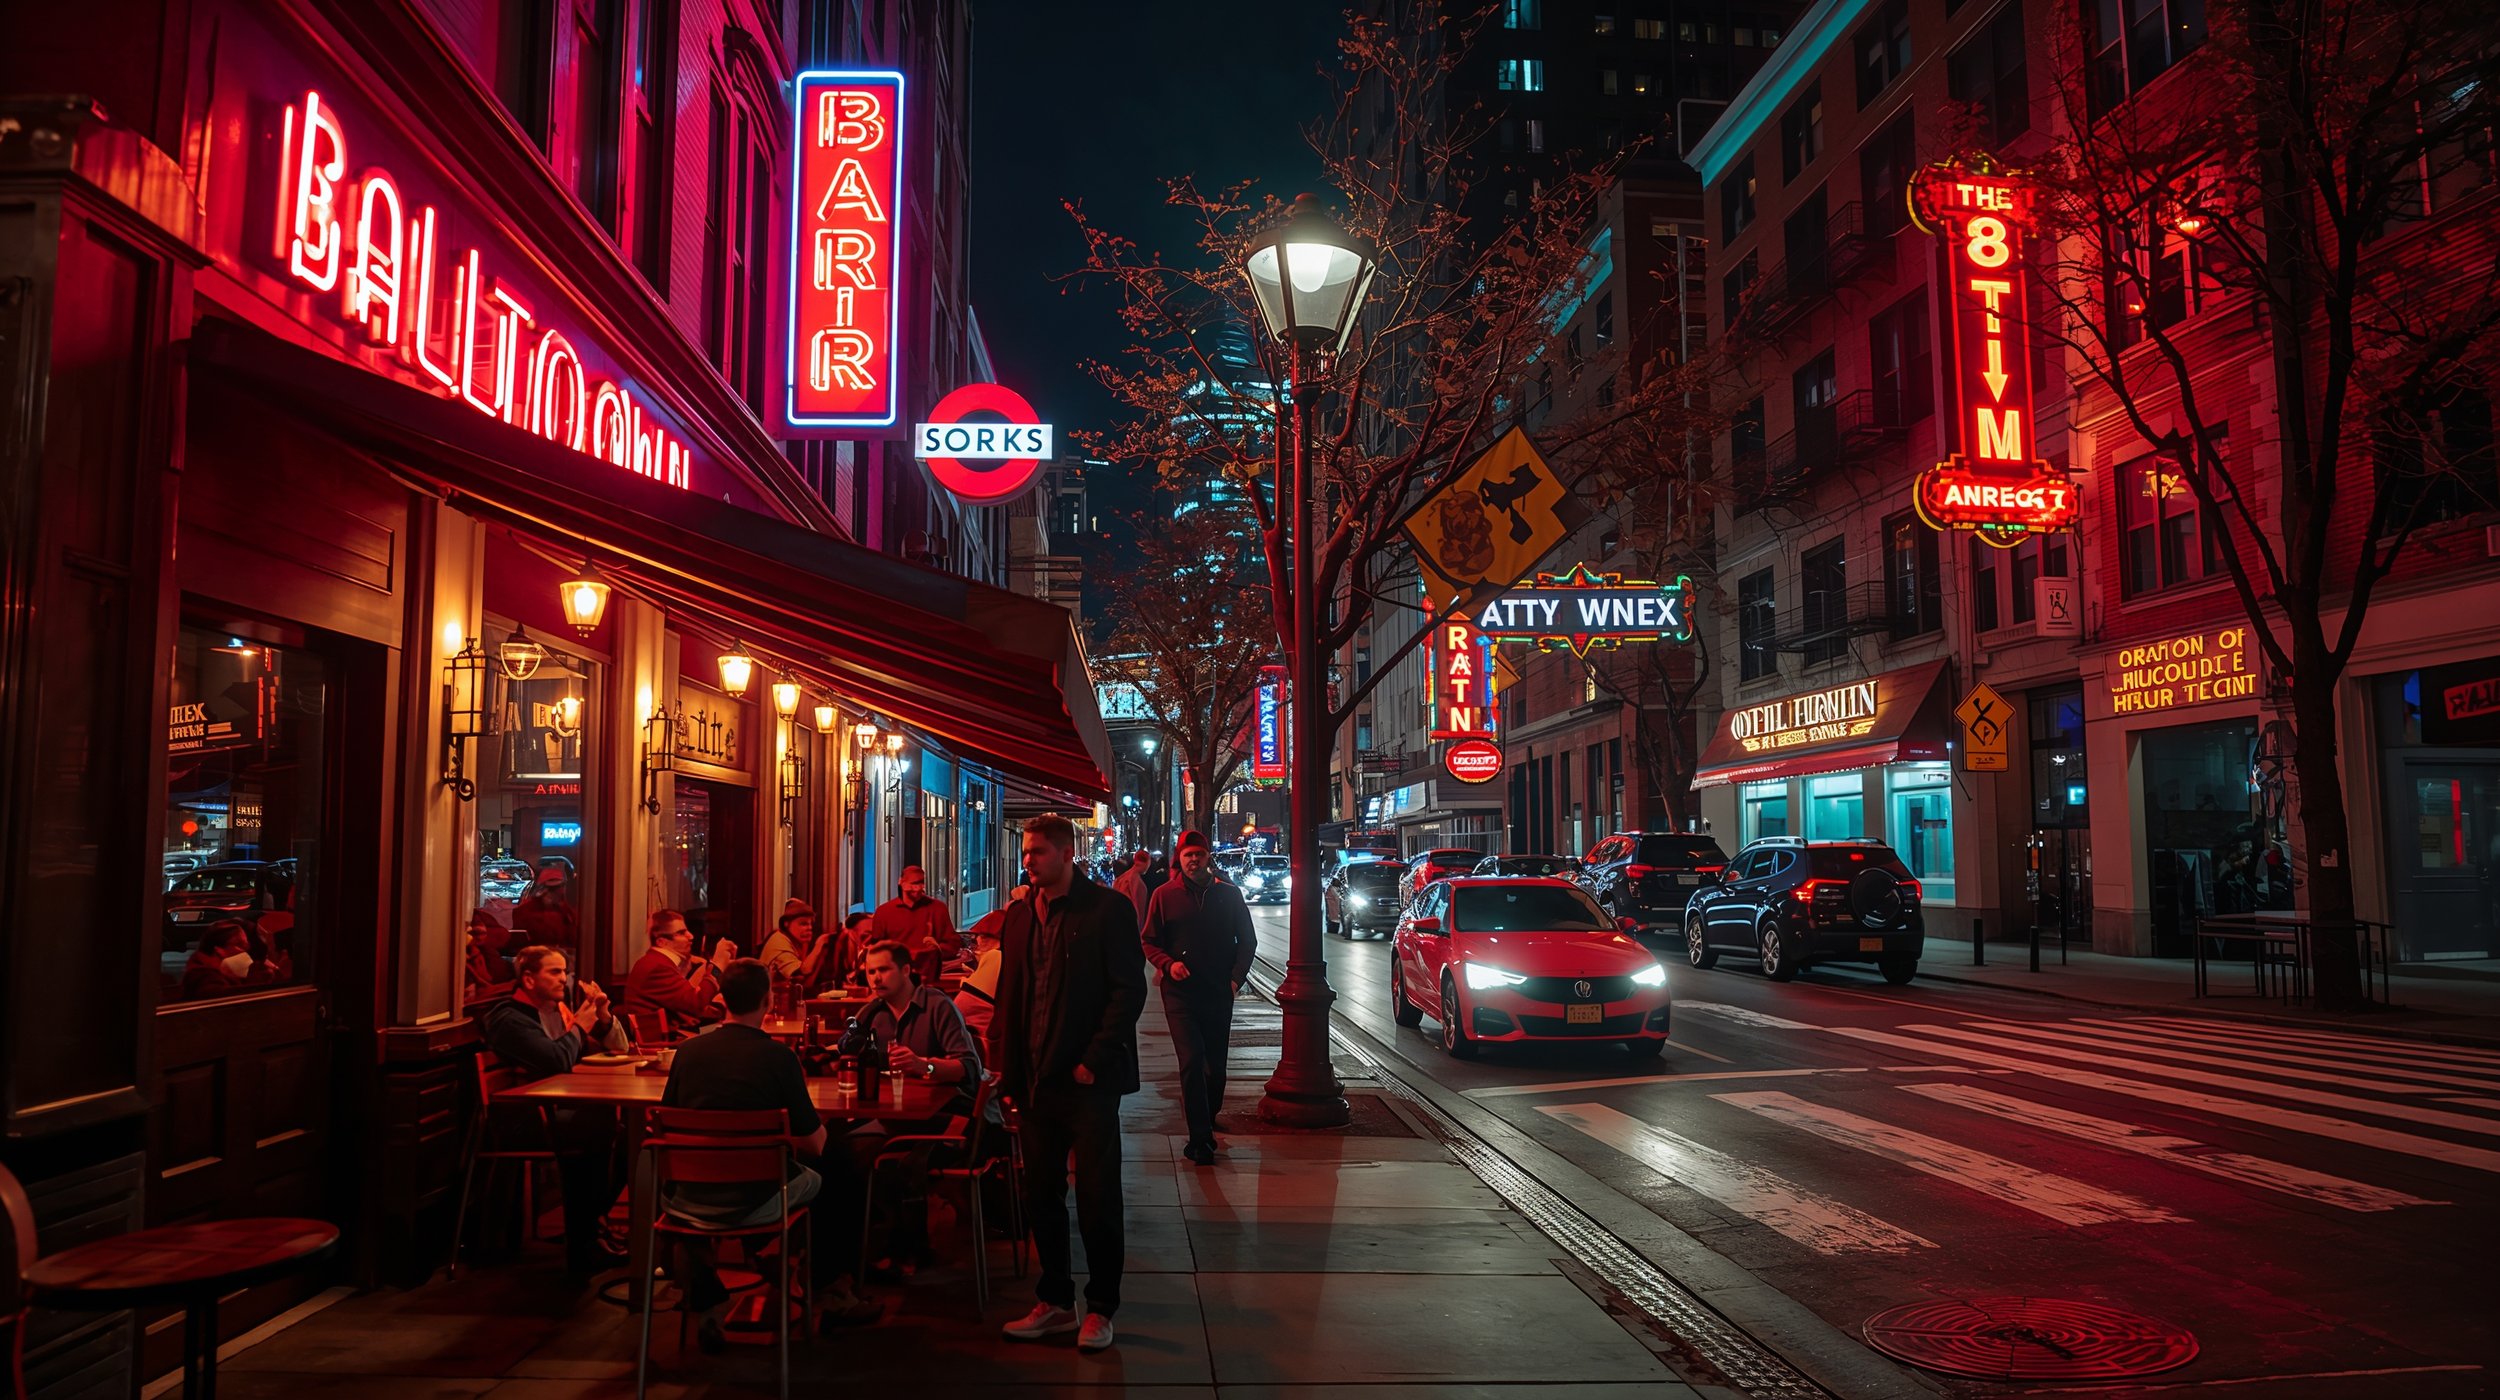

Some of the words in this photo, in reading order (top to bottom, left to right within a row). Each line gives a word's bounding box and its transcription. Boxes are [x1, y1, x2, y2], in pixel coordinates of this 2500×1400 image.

[1956, 183, 2014, 211] THE
[809, 91, 886, 392] BARIR
[925, 428, 1043, 453] SORKS
[1578, 598, 1679, 627] WNEX
[1448, 625, 1473, 733] RATN
